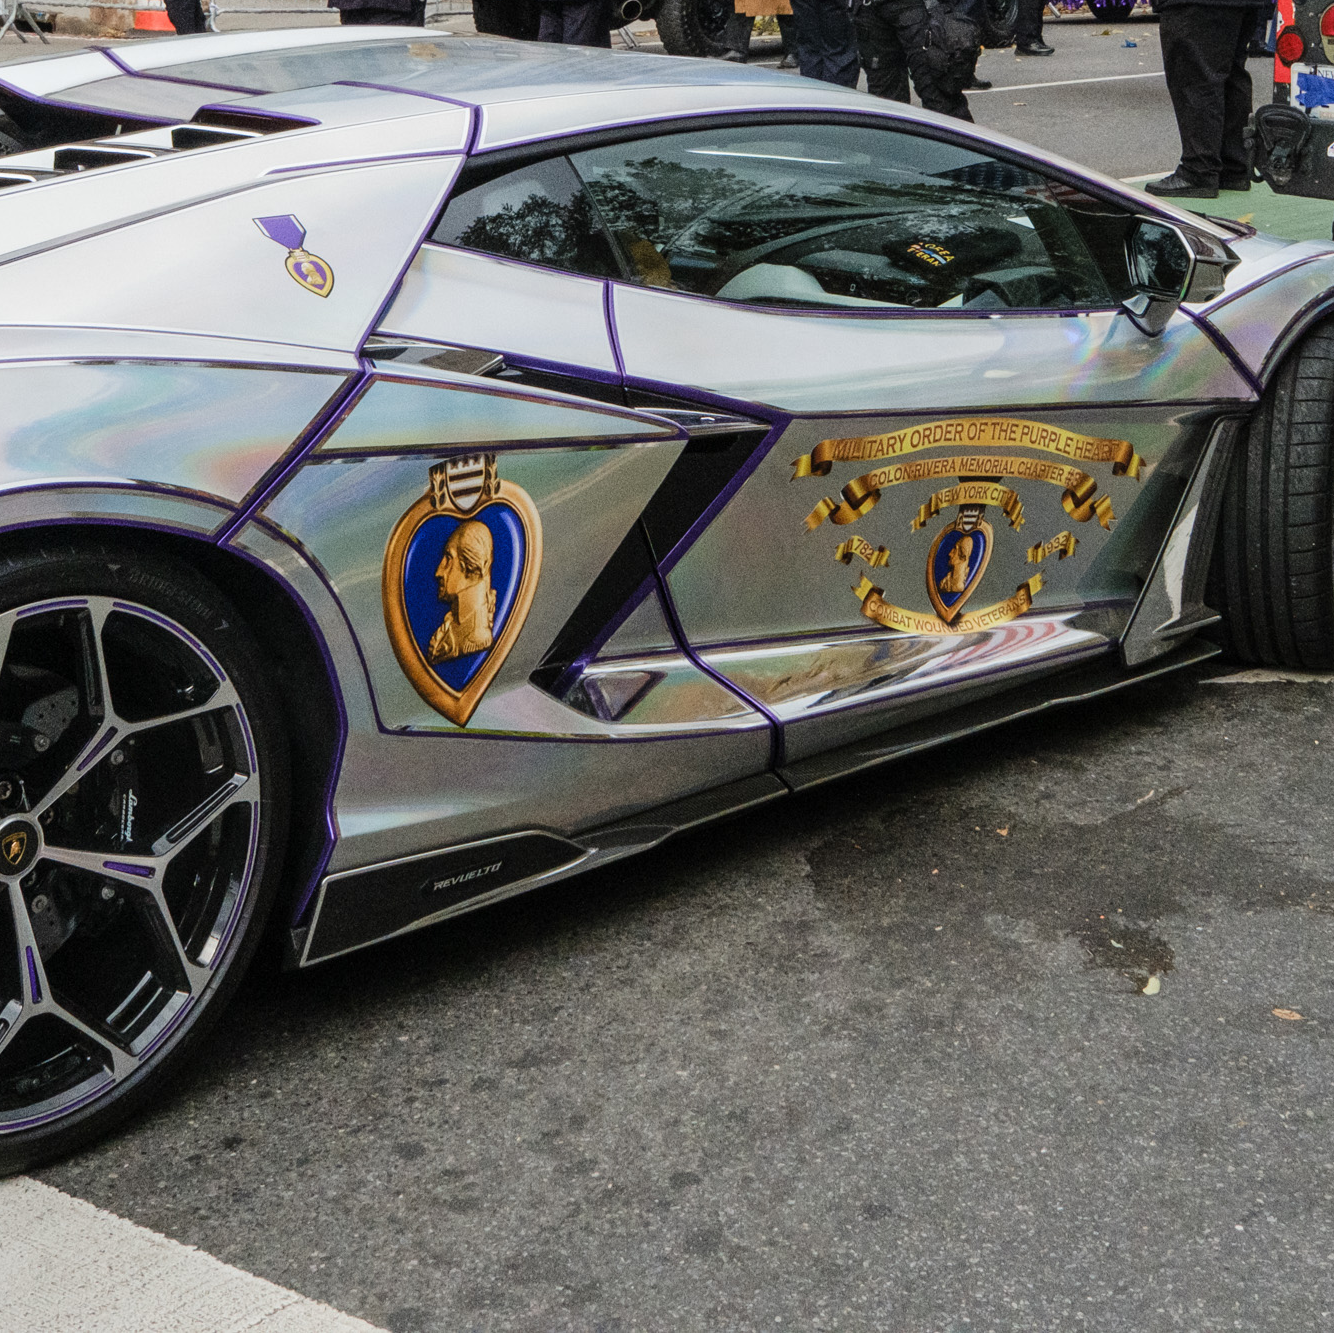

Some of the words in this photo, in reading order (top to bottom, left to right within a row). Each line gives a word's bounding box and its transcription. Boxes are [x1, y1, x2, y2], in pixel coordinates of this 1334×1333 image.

[832, 433, 905, 460] MILITARY
[910, 422, 964, 449] ORDER
[966, 421, 988, 441] OF
[989, 421, 1018, 441] THE
[1019, 424, 1071, 457] PURPLE
[1071, 440, 1120, 462] HEART
[870, 458, 957, 488] COLON-RIVERA
[958, 456, 1015, 476] MEMORIAL
[1017, 459, 1064, 484] CHAPTER
[935, 489, 961, 504] NEW
[962, 486, 988, 502] YORK
[989, 486, 1015, 503] CITY
[1042, 534, 1068, 556] 1932
[868, 600, 911, 629] COMBAT
[913, 618, 974, 635] WOUNDED
[974, 592, 1026, 629] VETERANS
[433, 861, 503, 891] REVUELTO
